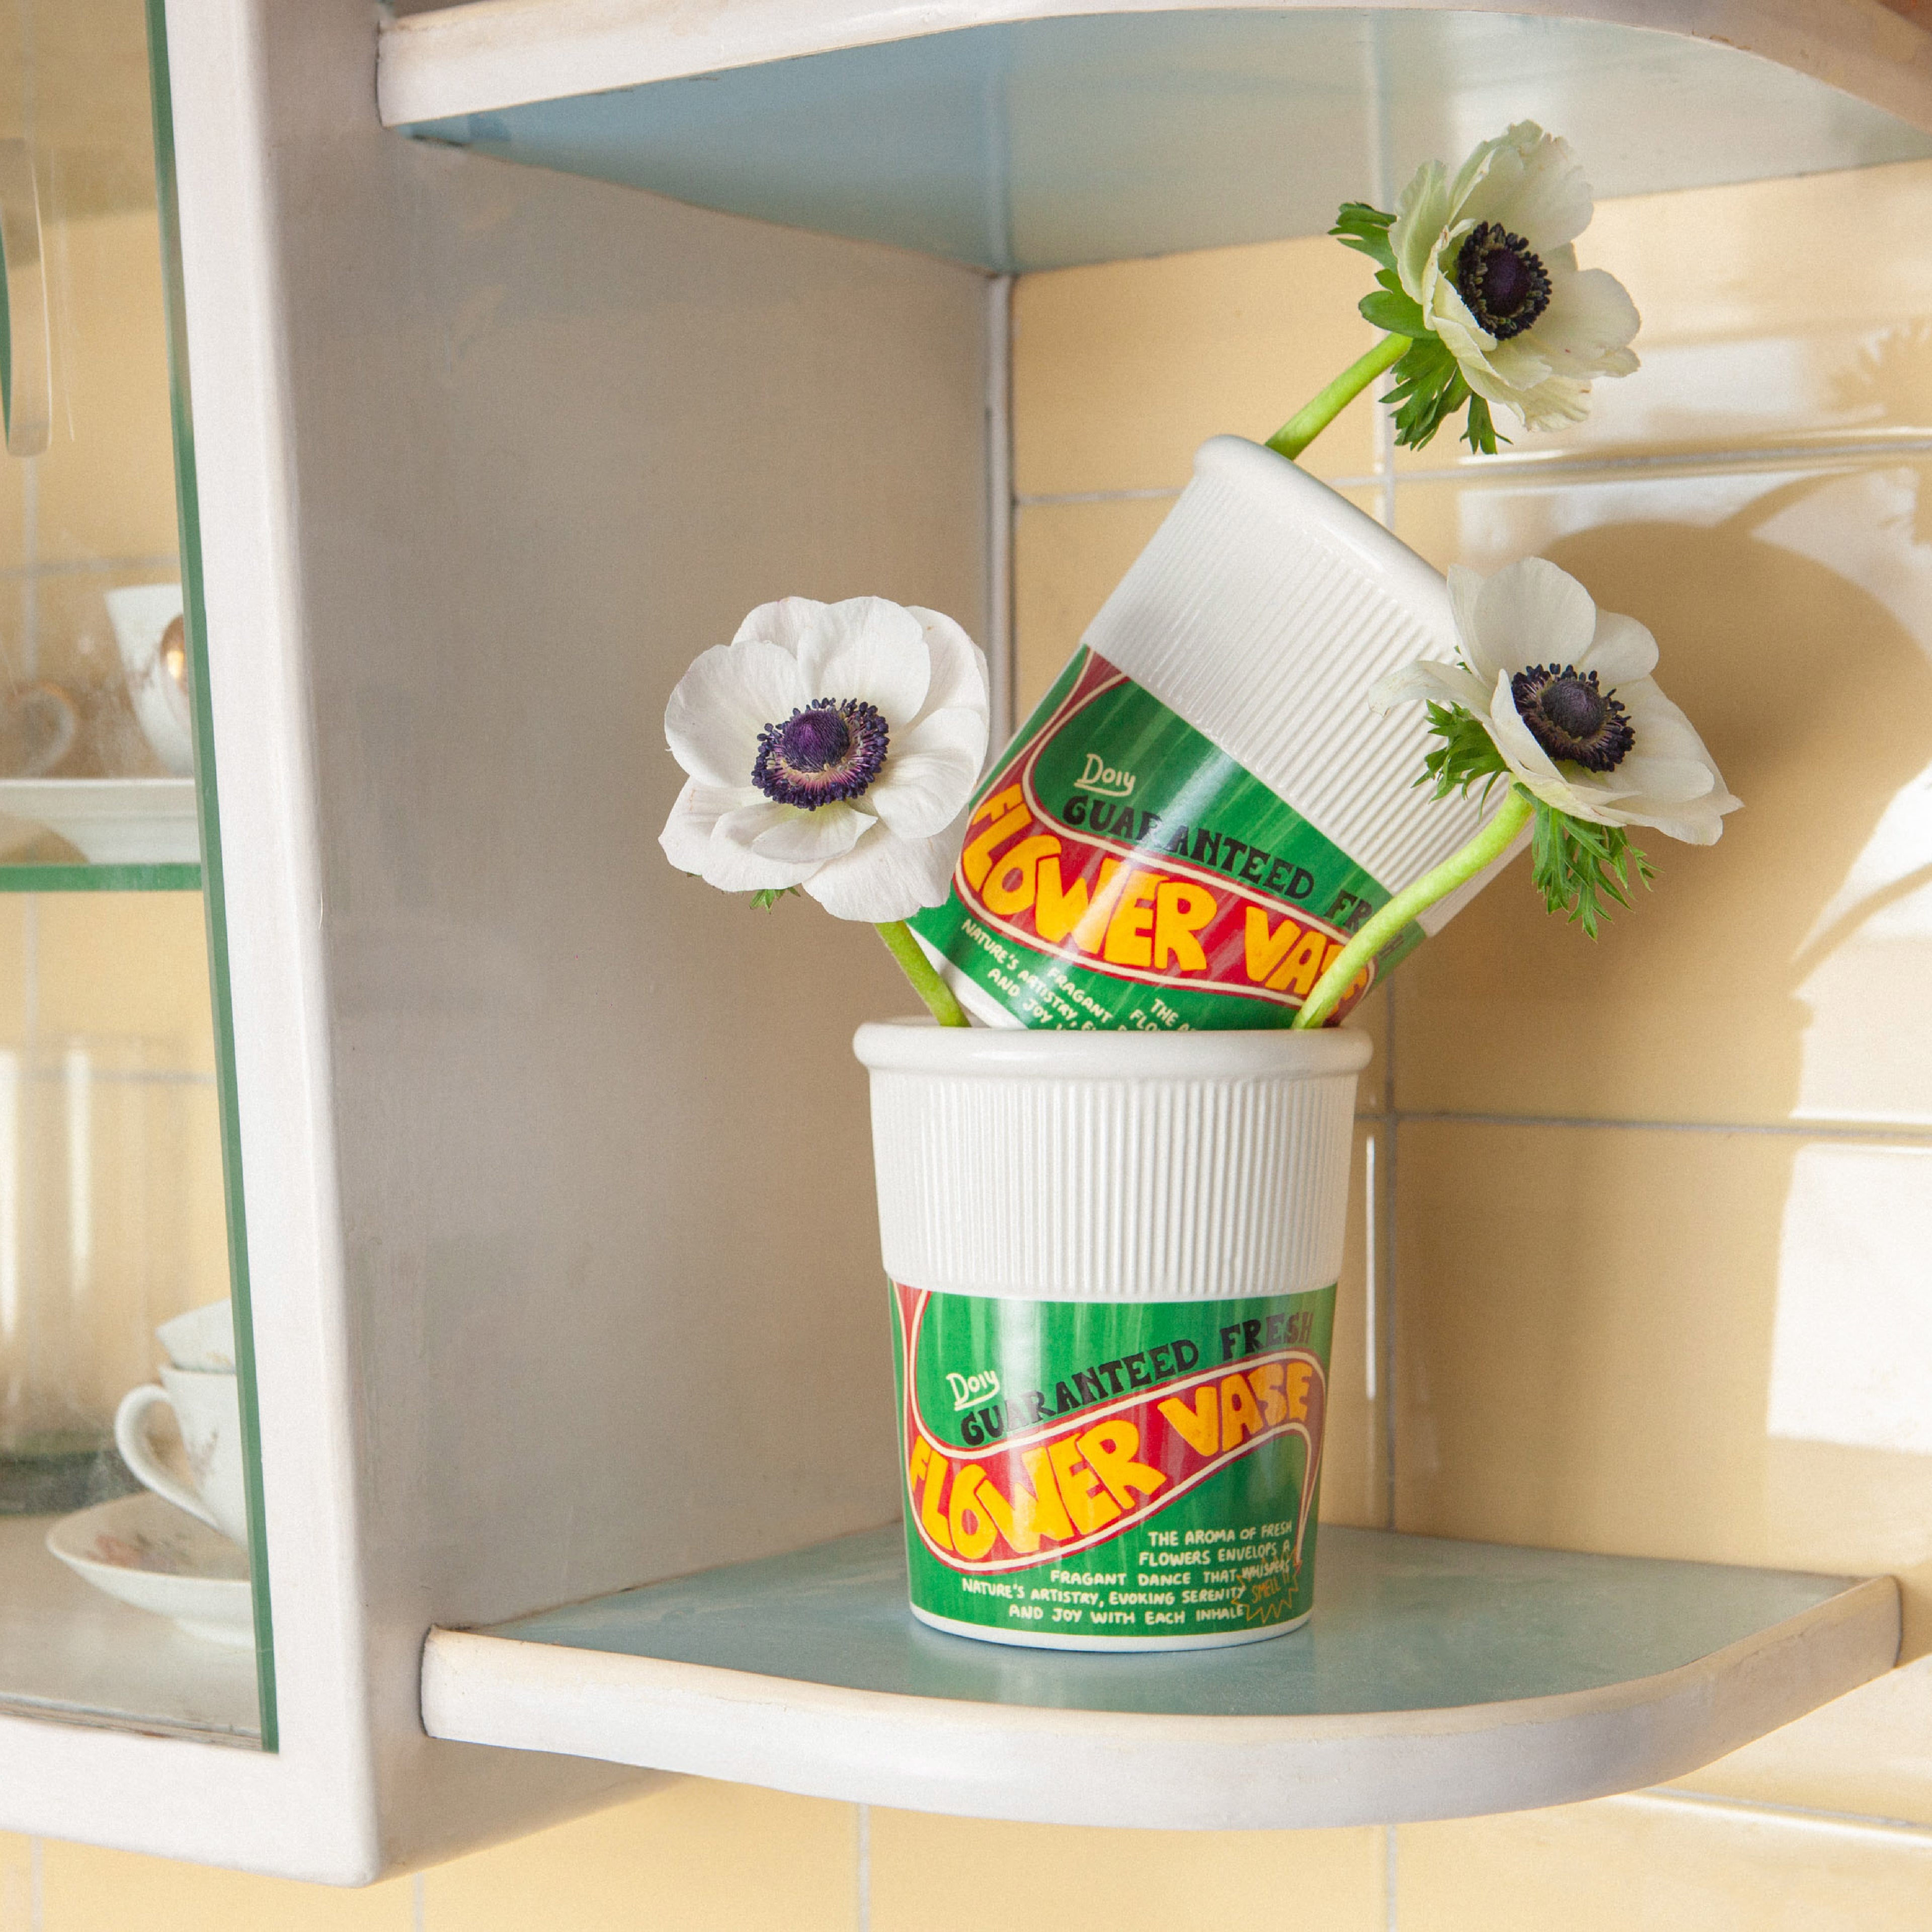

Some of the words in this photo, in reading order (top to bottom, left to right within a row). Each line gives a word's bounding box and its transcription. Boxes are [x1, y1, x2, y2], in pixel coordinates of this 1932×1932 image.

[1062, 794, 1315, 900] GUARANTEED
[962, 783, 1217, 971] FLOWER
[1244, 906, 1367, 1016] VA
[961, 919, 1019, 970] NATURE'S
[1017, 970, 1078, 1027] ARTISTRY,
[988, 969, 1020, 997] AND
[1022, 998, 1053, 1023] JOY
[1047, 967, 1113, 1023] FRAGANT
[1151, 998, 1178, 1027] THE
[960, 1339, 1199, 1445] GUARANTEED
[1220, 1311, 1314, 1361] FRESH
[910, 1419, 1167, 1560] FLOWER
[1157, 1362, 1313, 1457] VASE
[1139, 1550, 1211, 1567] FLOWERS
[1218, 1542, 1277, 1562] ENVELOPS
[1283, 1540, 1291, 1555] A
[1148, 1530, 1179, 1547] THE
[1185, 1529, 1235, 1546] AROMA
[1240, 1526, 1256, 1540] OF
[1261, 1520, 1292, 1538] FRESH
[961, 1577, 1025, 1599] NATURE'S
[1031, 1588, 1104, 1608] ARTISTRY,
[1108, 1591, 1175, 1605] EVOKING
[1181, 1585, 1247, 1604] SERENITY
[1051, 1570, 1127, 1585] FRAGANT
[1138, 1572, 1191, 1586] DANCE
[1203, 1568, 1237, 1584] THAT
[1009, 1604, 1043, 1620] AND
[1052, 1608, 1082, 1623] JOY
[1090, 1612, 1136, 1624] WITH
[1144, 1611, 1185, 1625] EACH
[1196, 1604, 1244, 1622] INHALE
